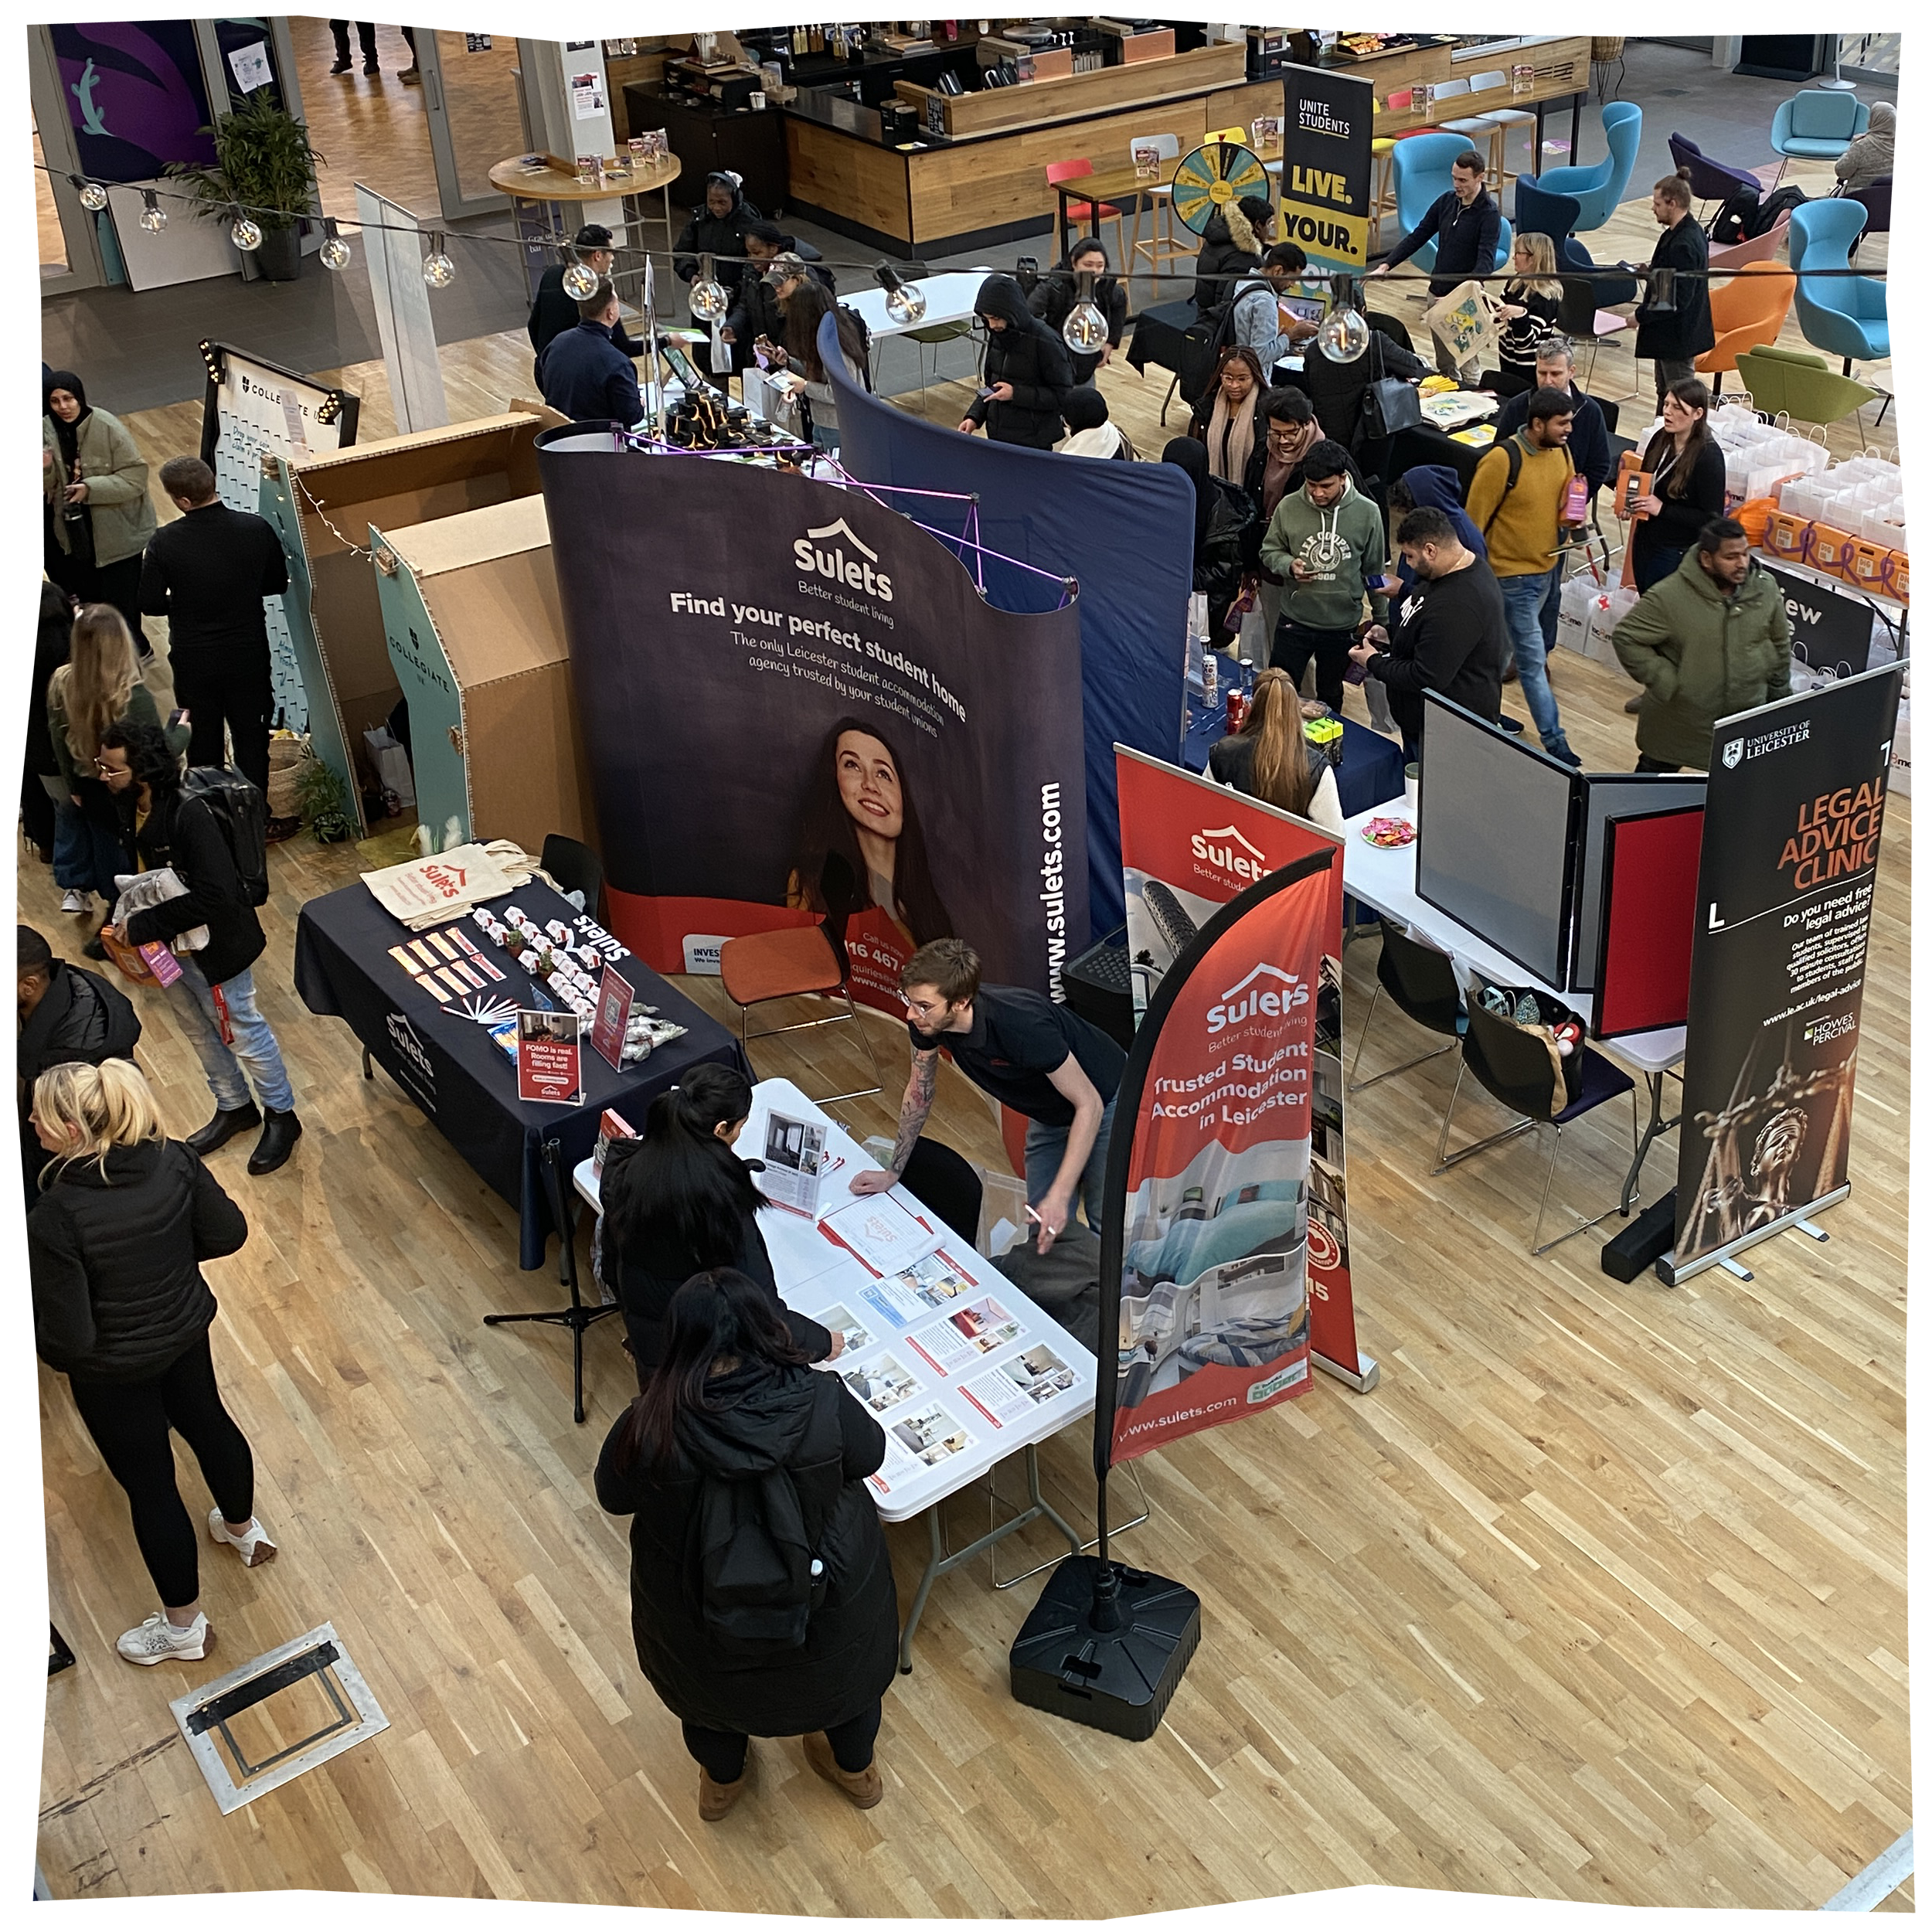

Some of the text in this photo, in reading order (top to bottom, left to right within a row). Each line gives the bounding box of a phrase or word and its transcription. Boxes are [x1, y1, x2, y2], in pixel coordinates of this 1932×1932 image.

[1298, 98, 1330, 117] UNITE
[1298, 112, 1351, 135] STUDENTS
[1291, 165, 1353, 205] LIVE.
[1283, 211, 1359, 255] YOUR.
[252, 384, 308, 417] COLLETE
[1299, 535, 1318, 558] LEE
[1777, 529, 1791, 541] DIG
[1820, 543, 1832, 555] DIG
[793, 538, 893, 602] Sulets
[1859, 558, 1872, 570] DIG
[1899, 573, 1913, 586] DIG
[798, 580, 895, 630] Better student living
[1558, 611, 1582, 627] oc8me
[389, 635, 450, 693] COLLEGIATE
[669, 592, 967, 723] Find your perfect student home
[730, 630, 945, 726] The only Leicester student accommodation
[748, 656, 938, 739] agency trusted by your student unions
[1747, 719, 1811, 747] UNIVERSITY OF
[1747, 729, 1810, 760] LEICESTER
[1797, 776, 1884, 833] LEGAL
[1777, 807, 1882, 870] ADVICE
[1794, 833, 1879, 890] CLINIC
[420, 865, 460, 898] Sulets
[1039, 781, 1067, 1005] www.sulets.com
[1193, 863, 1247, 893] Better stude
[1783, 883, 1872, 928] Do you need free
[1805, 893, 1872, 930] legal advice?
[572, 914, 631, 962] Sulets
[862, 932, 905, 959] Call us now
[1791, 941, 1804, 951] Our
[1805, 934, 1824, 946] team
[1824, 928, 1833, 939] of
[1833, 920, 1859, 935] trained
[1792, 944, 1822, 960] students,
[1824, 928, 1861, 947] supervised
[693, 947, 720, 957] INVES
[872, 949, 899, 971] 467
[1786, 954, 1816, 971] qualified
[1816, 941, 1849, 957] solicitors,
[1789, 940, 1866, 978] 30 minute consultations
[1796, 974, 1804, 983] to
[1804, 963, 1837, 979] students,
[1837, 953, 1855, 968] staff
[1790, 975, 1821, 994] members
[1821, 971, 1832, 981] of
[1832, 967, 1845, 978] the
[1206, 983, 1310, 1034] Sulets
[1763, 978, 1862, 1027] www.le.ac.uk/legal-advice
[1208, 1031, 1242, 1053] Better
[1243, 1025, 1284, 1039] student
[1812, 1019, 1857, 1046] PERCIVAL
[1814, 1012, 1854, 1036] HOWES
[386, 1015, 434, 1077] Sulets
[526, 1044, 573, 1056] FOMO is real.
[531, 1052, 556, 1061] Rooms
[532, 1060, 552, 1070] filling
[1154, 1041, 1308, 1095] Trusted Student
[1151, 1067, 1308, 1121] Accommodation
[1199, 1091, 1308, 1131] in Leicester
